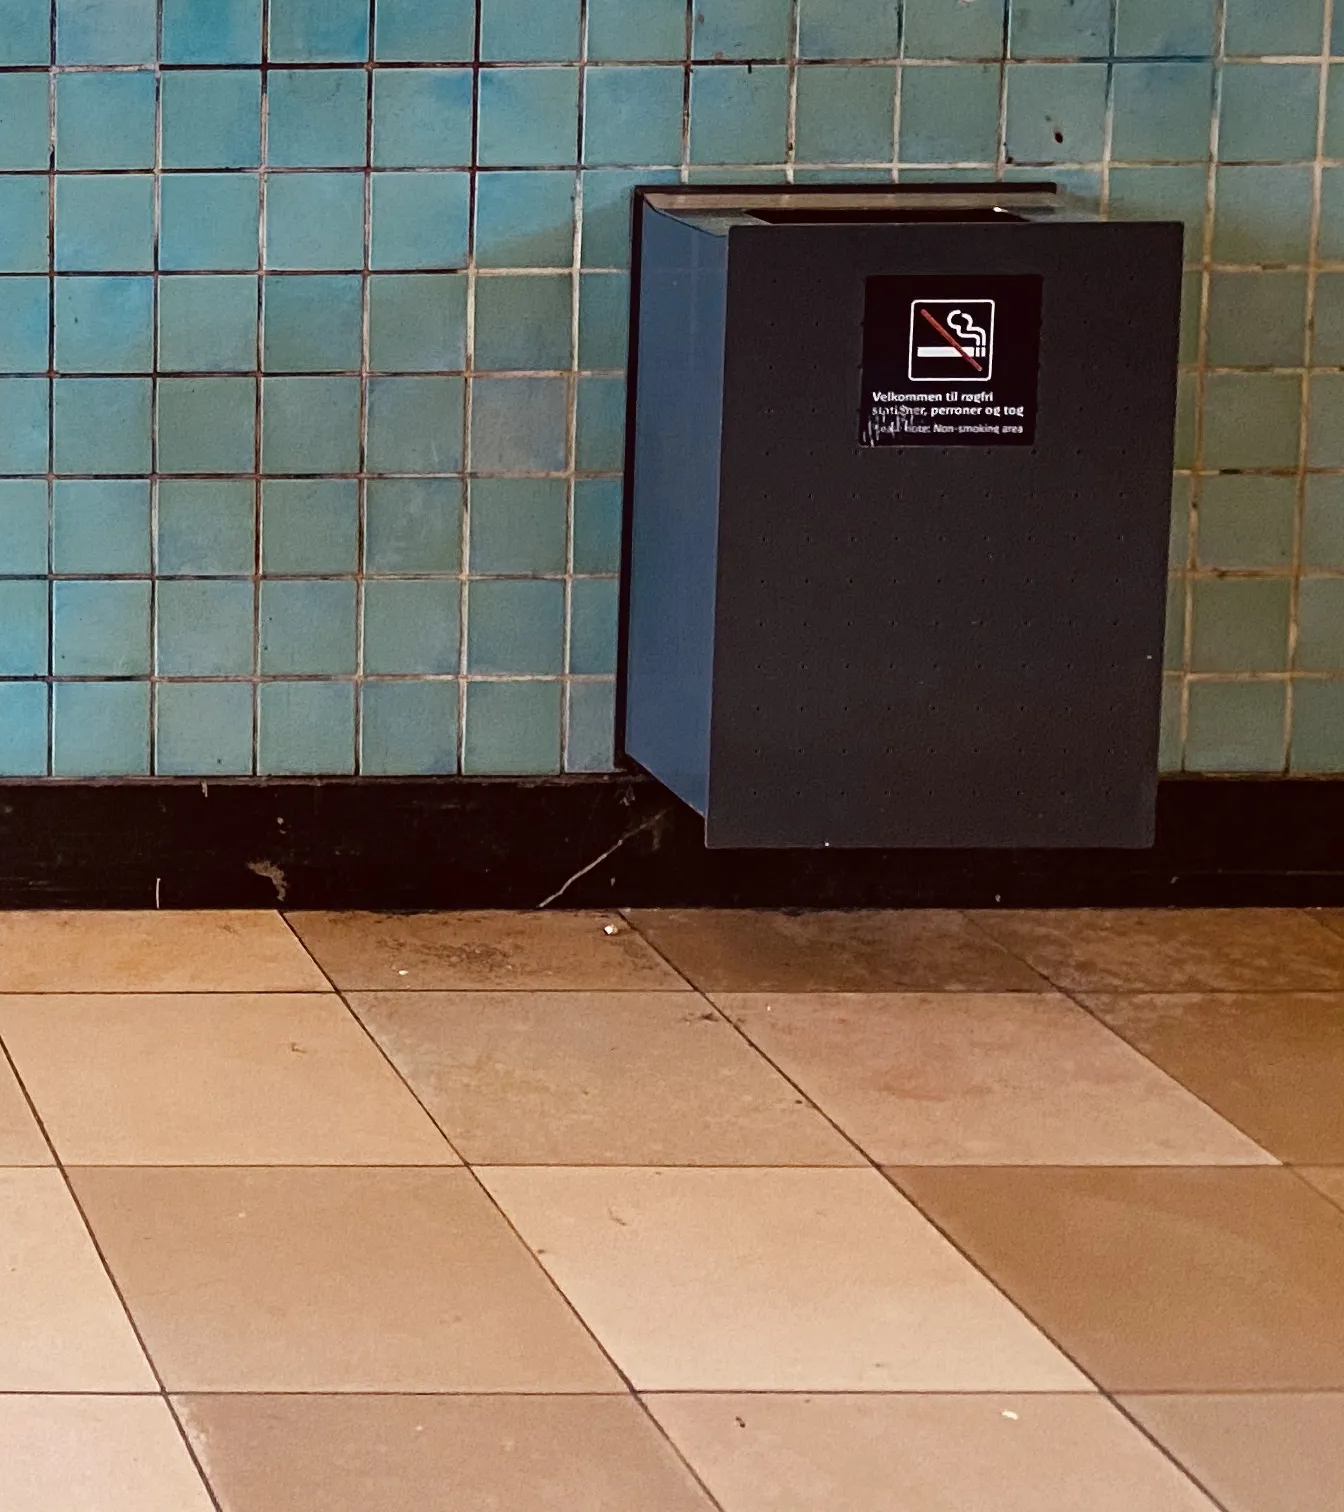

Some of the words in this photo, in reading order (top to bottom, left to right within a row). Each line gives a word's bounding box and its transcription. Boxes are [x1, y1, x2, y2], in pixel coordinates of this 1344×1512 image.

[872, 391, 943, 402] Velkommen
[945, 391, 958, 402] til
[961, 391, 993, 404] røgfri
[931, 406, 983, 418] perroner
[984, 406, 1001, 418] og
[1003, 406, 1025, 418] tog
[933, 424, 1000, 435] Non-smoking
[1002, 425, 1024, 434] area
